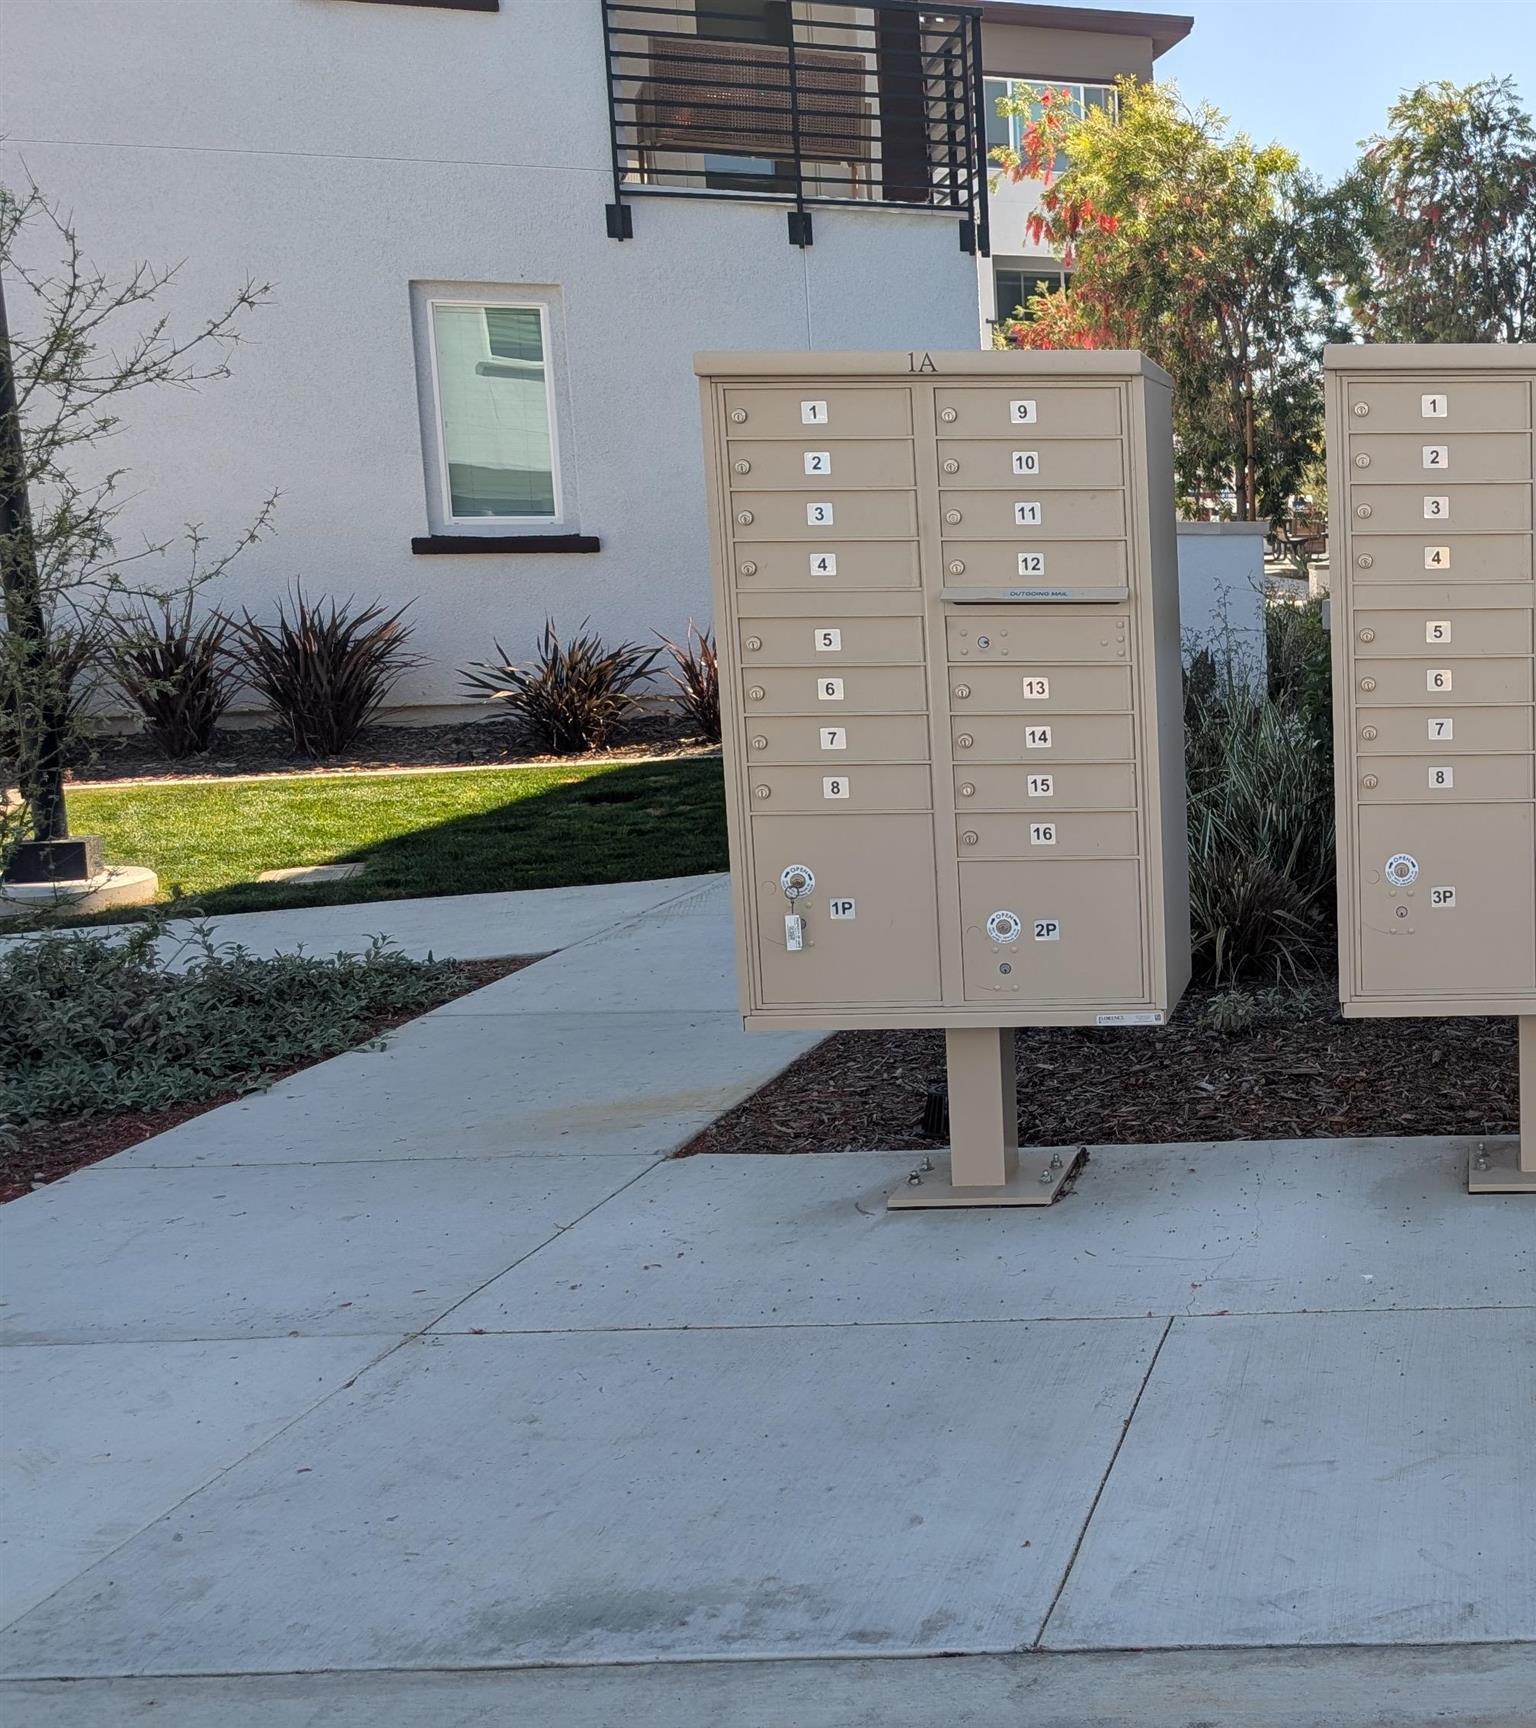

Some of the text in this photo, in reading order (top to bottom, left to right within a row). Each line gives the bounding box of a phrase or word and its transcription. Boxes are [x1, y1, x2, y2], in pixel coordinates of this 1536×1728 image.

[907, 352, 939, 373] 1A
[809, 405, 817, 420] 1
[1017, 404, 1028, 419] 9
[1429, 398, 1437, 413] 1
[811, 455, 822, 471] 2
[1015, 455, 1035, 470] 10
[1430, 449, 1440, 465] 2
[814, 506, 825, 521] 3
[1017, 506, 1036, 521] 11
[1431, 500, 1441, 515] 3
[817, 557, 828, 572] 4
[1021, 557, 1041, 571] 12
[1431, 550, 1442, 565] 4
[822, 632, 833, 647] 5
[1433, 625, 1443, 639] 5
[1026, 680, 1046, 695] 13
[1434, 673, 1444, 688] 6
[825, 682, 835, 697] 6
[1028, 729, 1049, 744] 14
[1435, 722, 1445, 736] 7
[827, 731, 837, 746] 7
[1435, 770, 1445, 785] 8
[830, 780, 841, 795] 8
[1030, 778, 1050, 793] 15
[1033, 826, 1053, 841] 16
[1432, 890, 1454, 904] 3P
[831, 901, 853, 915] 1P
[1035, 923, 1057, 937] 2P
